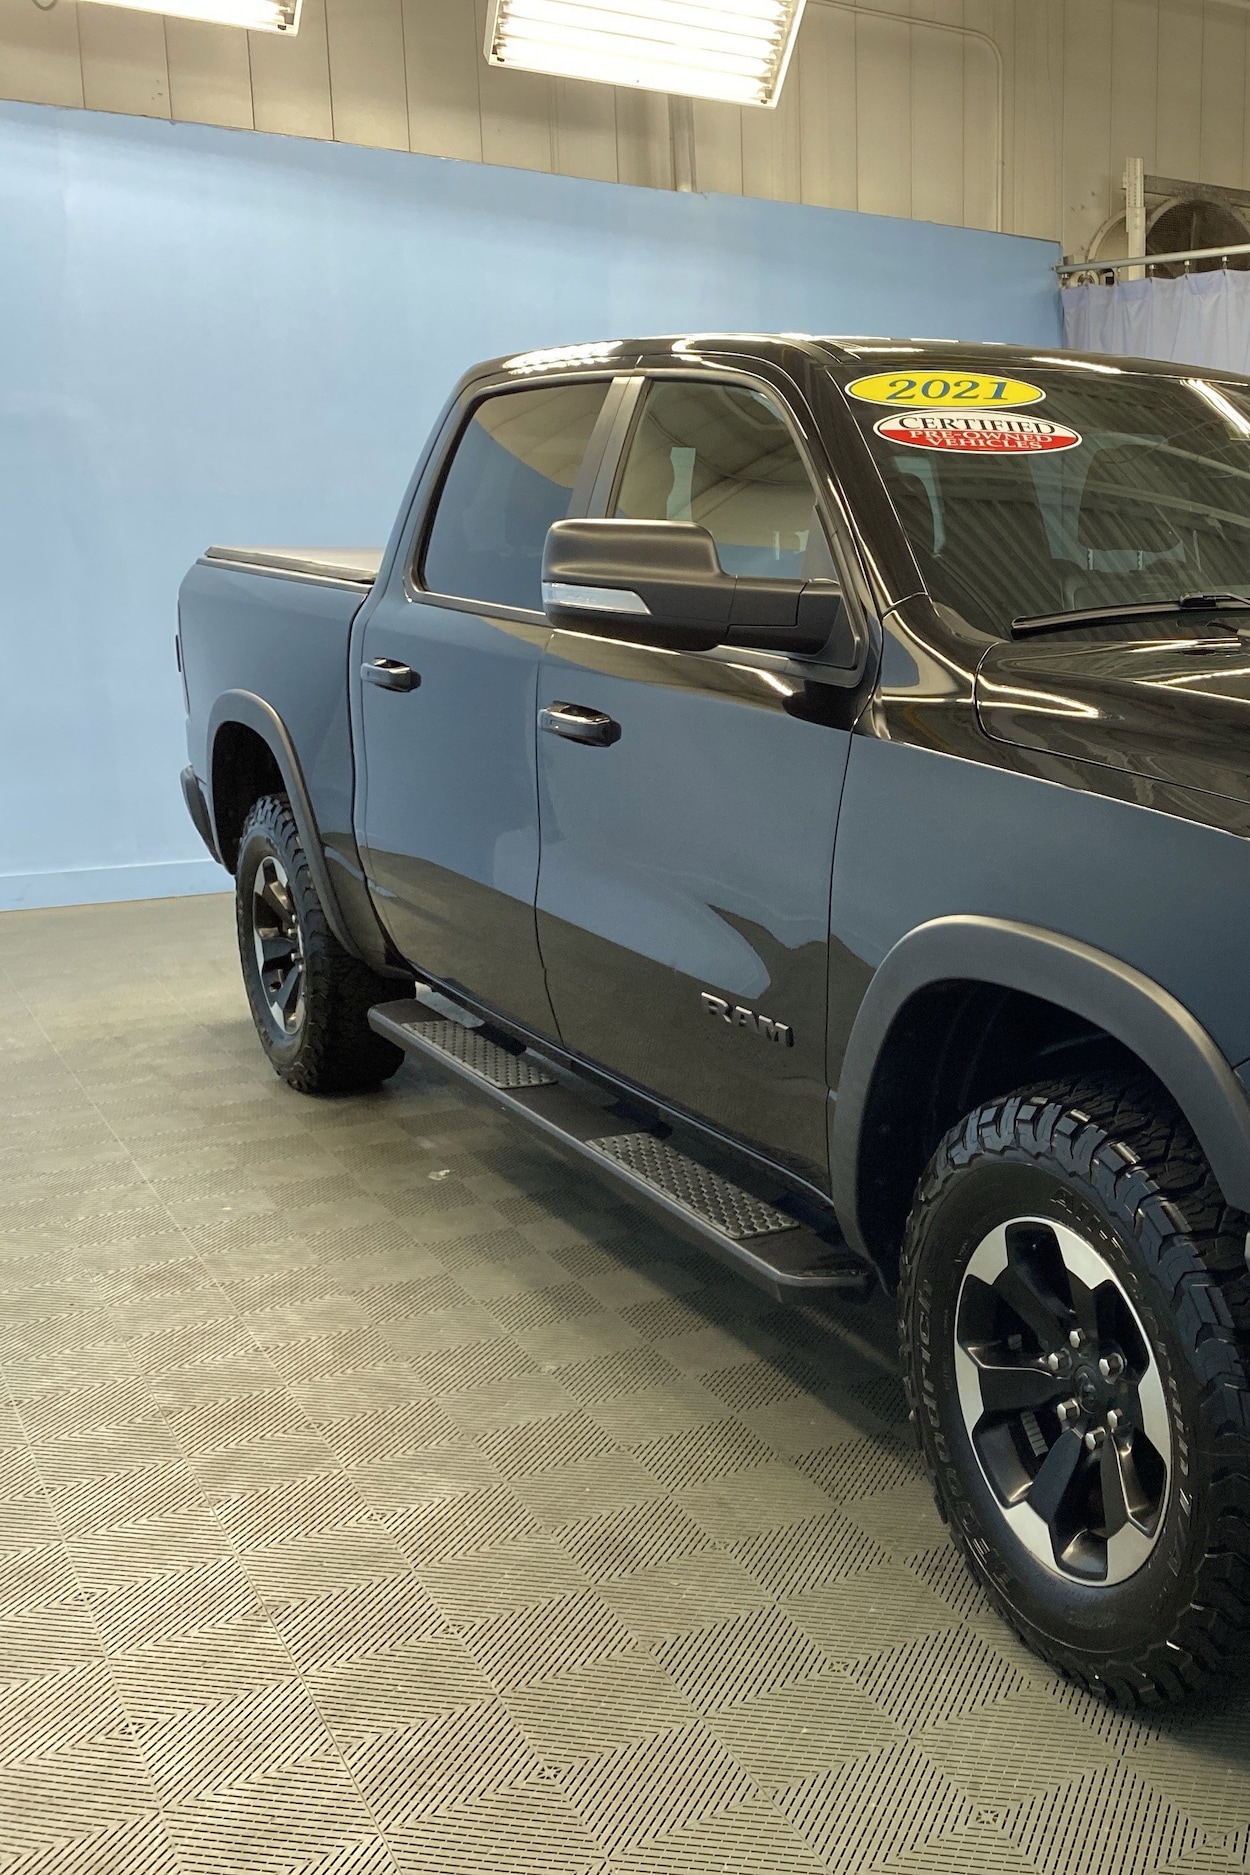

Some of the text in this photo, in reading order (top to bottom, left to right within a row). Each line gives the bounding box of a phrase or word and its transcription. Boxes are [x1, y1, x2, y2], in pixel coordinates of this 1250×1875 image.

[886, 379, 1008, 400] 2021
[899, 416, 1056, 435] CERTIFIED
[909, 430, 1053, 443] PRE-OWNED
[926, 438, 1042, 449] VEHICLES
[701, 992, 794, 1048] RAM
